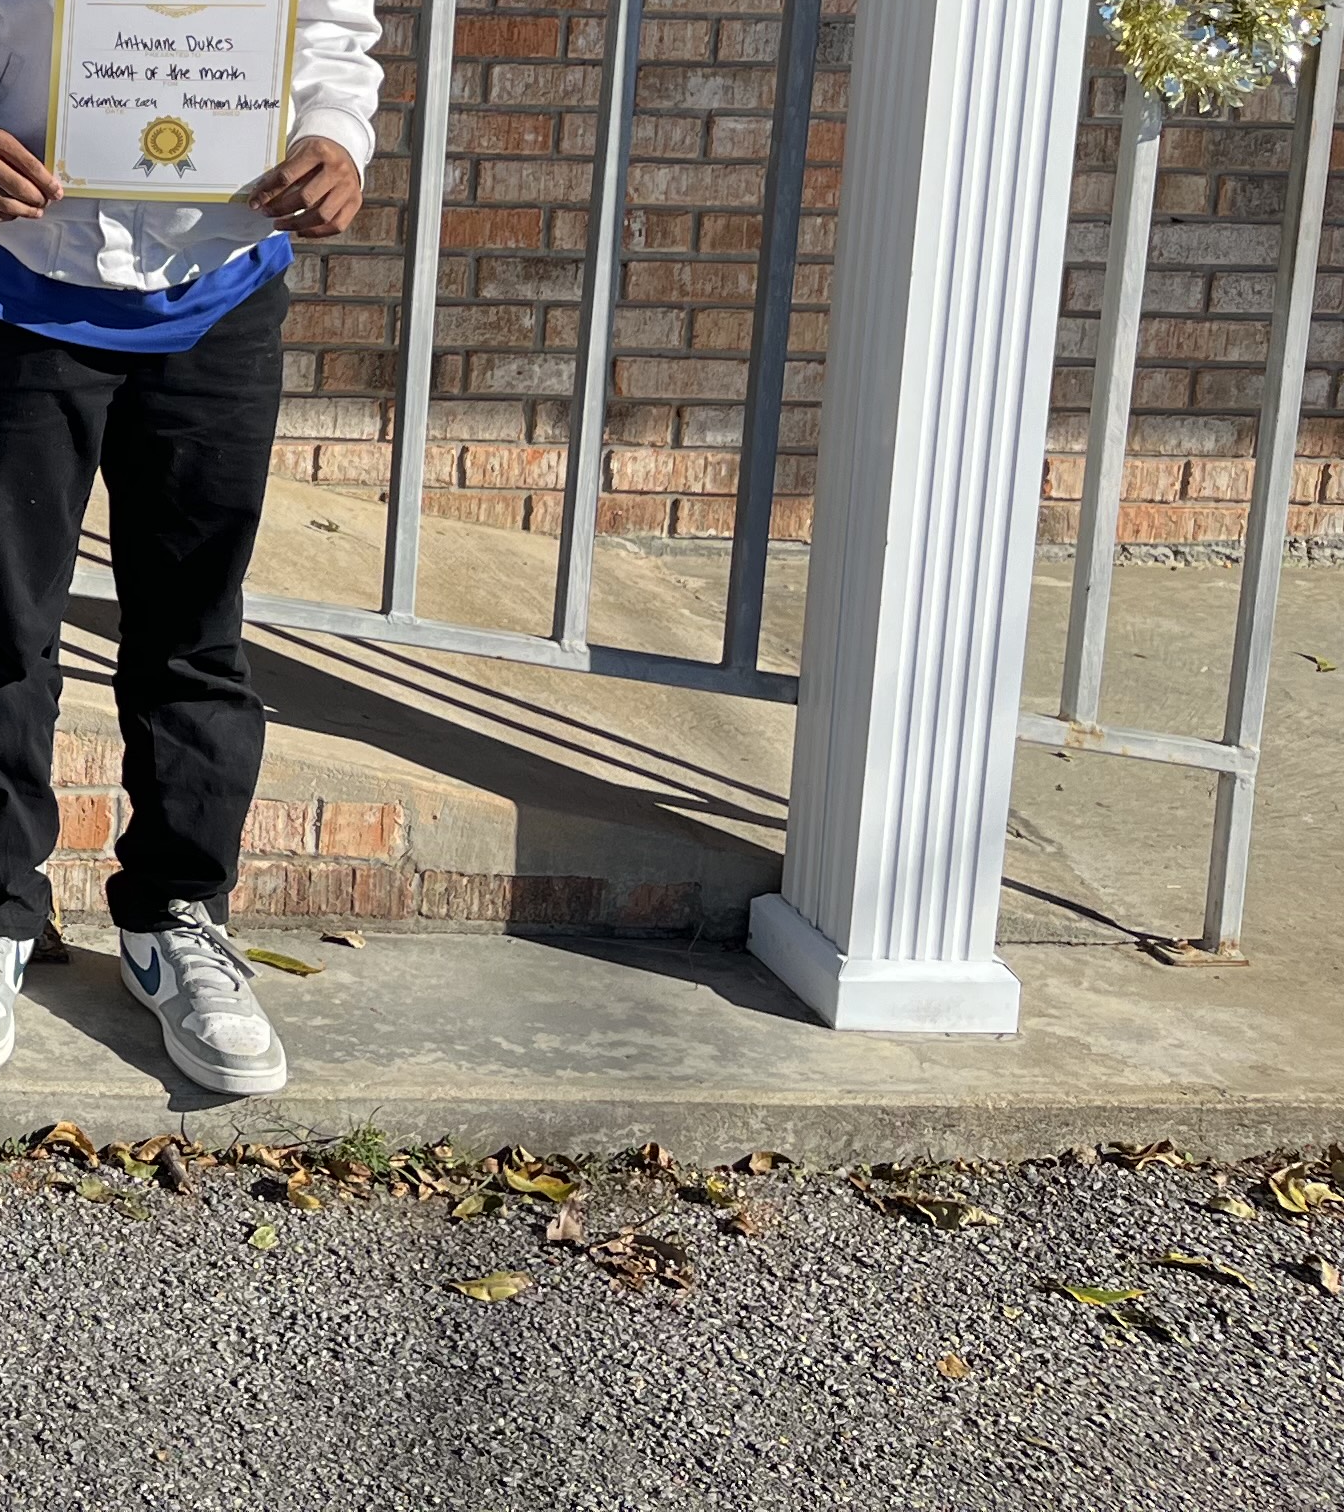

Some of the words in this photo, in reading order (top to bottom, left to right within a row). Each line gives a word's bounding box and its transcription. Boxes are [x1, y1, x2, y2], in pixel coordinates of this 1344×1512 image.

[114, 31, 176, 51] Antwane
[185, 35, 234, 52] Dukes
[82, 60, 138, 81] Student
[166, 63, 190, 80] the
